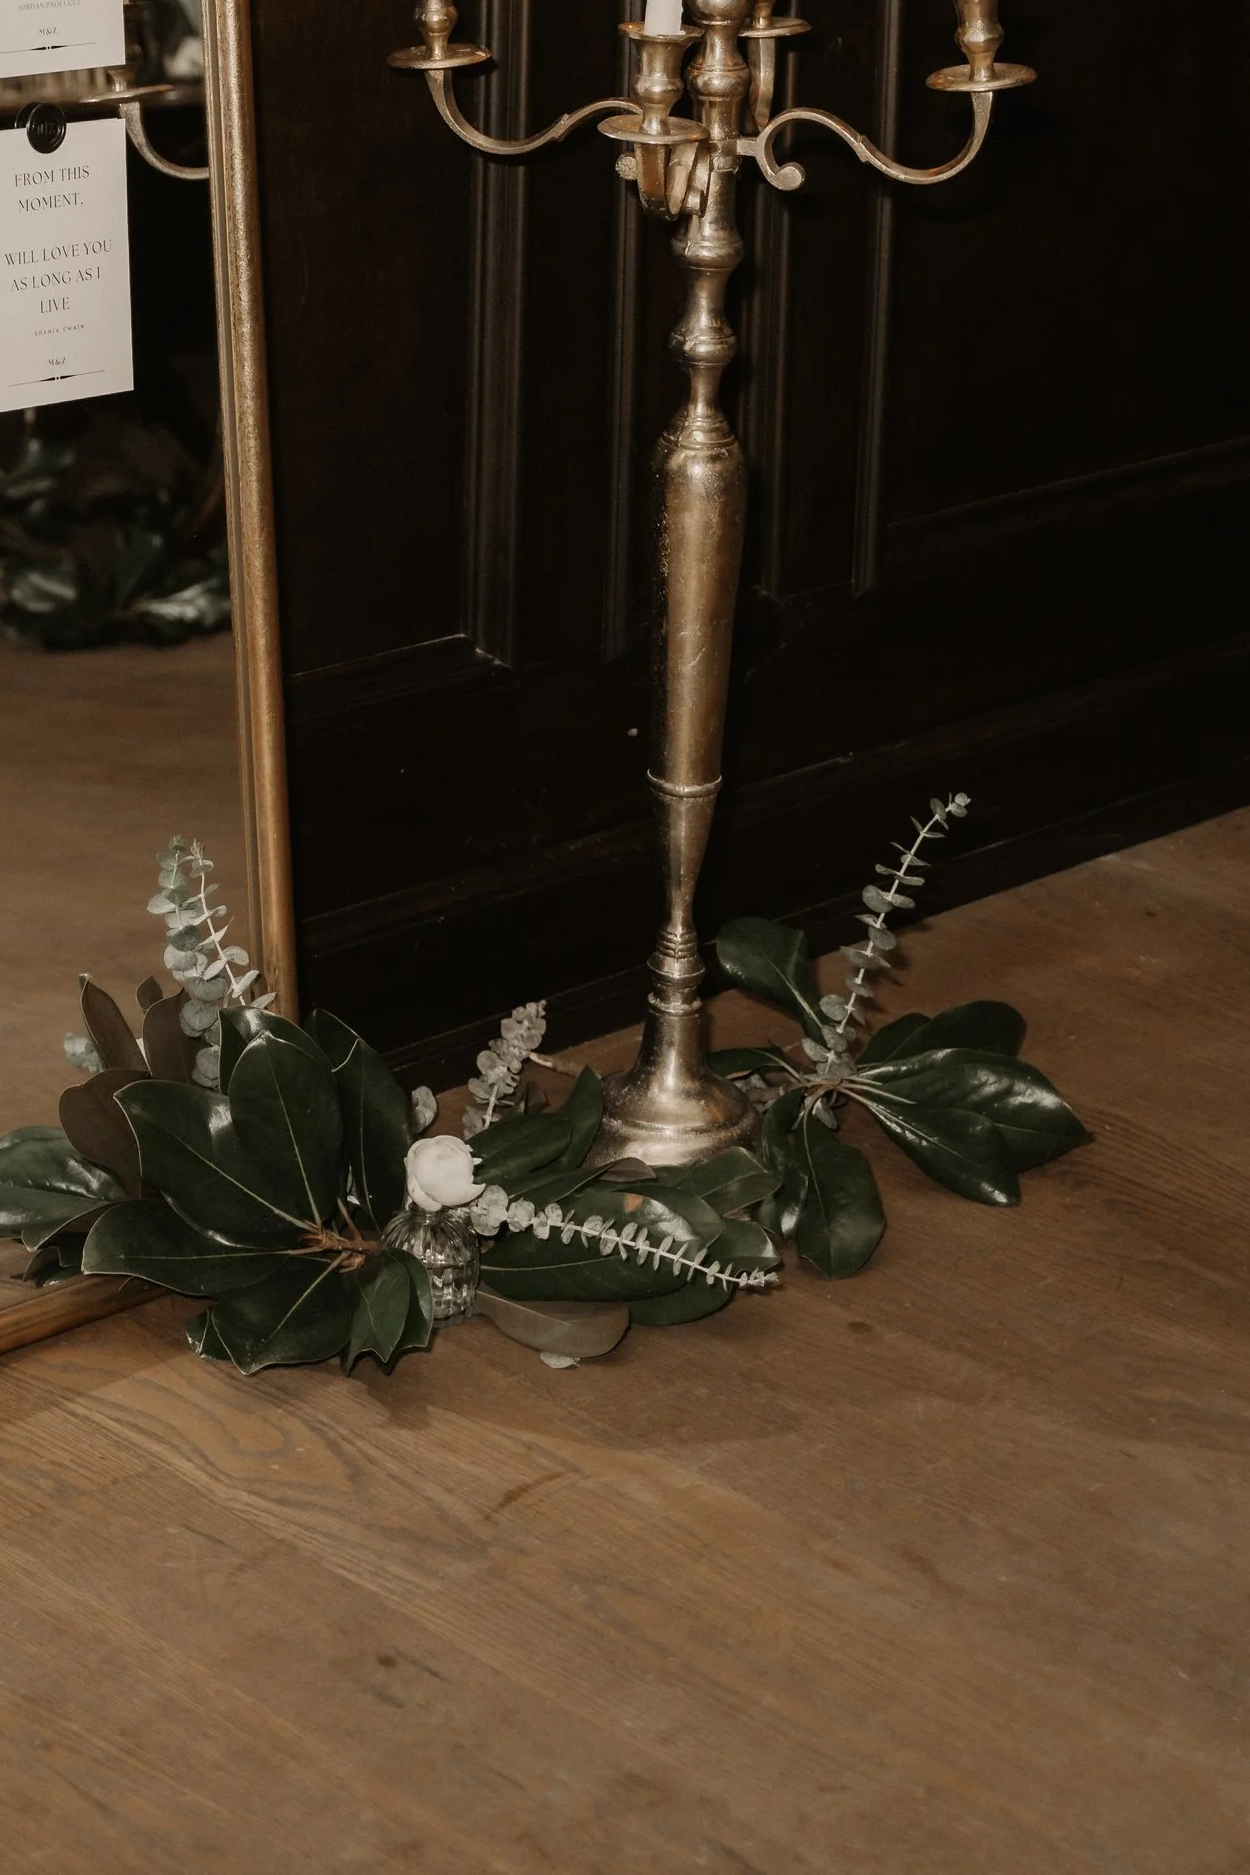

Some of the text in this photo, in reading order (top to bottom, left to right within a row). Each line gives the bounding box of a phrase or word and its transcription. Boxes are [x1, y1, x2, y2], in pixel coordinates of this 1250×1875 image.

[15, 166, 89, 187] FROM THIS
[5, 250, 38, 265] WILL
[43, 244, 79, 261] LOVE
[84, 239, 111, 255] YOU
[11, 277, 27, 290] AS
[33, 271, 71, 288] LONG
[76, 268, 92, 282] AS
[41, 297, 69, 313] LIVE
[49, 357, 66, 366] M&Z
